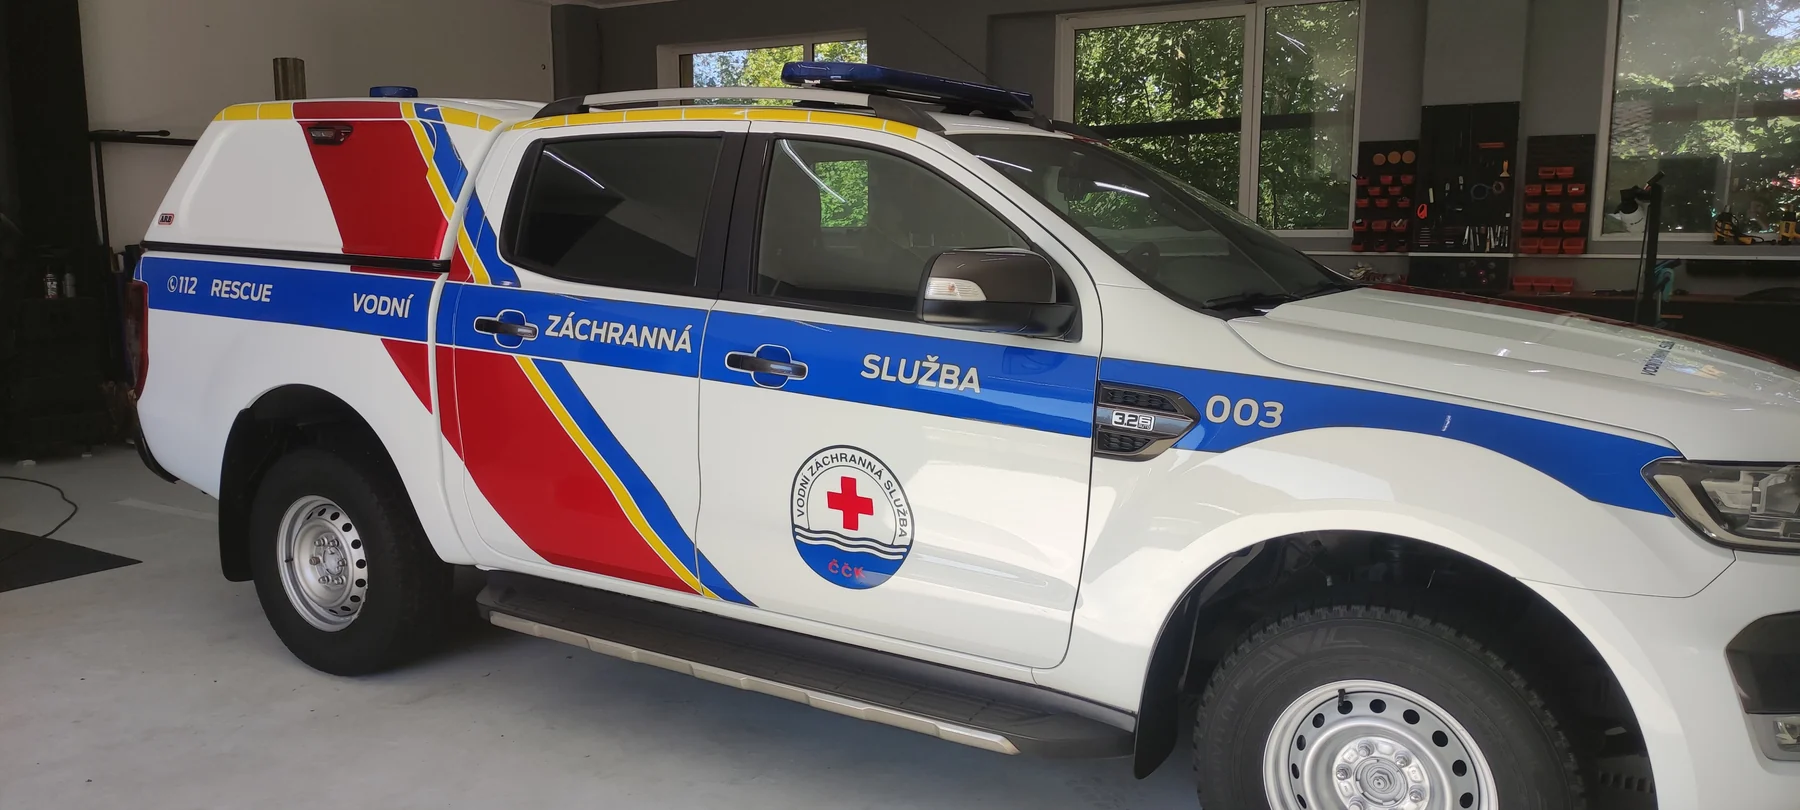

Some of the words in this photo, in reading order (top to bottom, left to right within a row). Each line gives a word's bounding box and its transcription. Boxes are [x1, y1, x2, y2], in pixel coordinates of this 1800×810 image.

[179, 276, 198, 295] 112
[211, 279, 273, 302] RESCUE
[353, 292, 415, 319] VODNÍ
[545, 311, 693, 354] ZÁCHRANNÁ
[860, 353, 980, 394] SLUŽBA
[1114, 411, 1138, 427] 3.2
[1206, 394, 1284, 429] 003
[796, 472, 811, 517] VODNÍ
[807, 452, 884, 480] ZÁCHRANNÁ
[884, 480, 908, 538] SLUŽBA
[827, 558, 866, 579] ČČK
